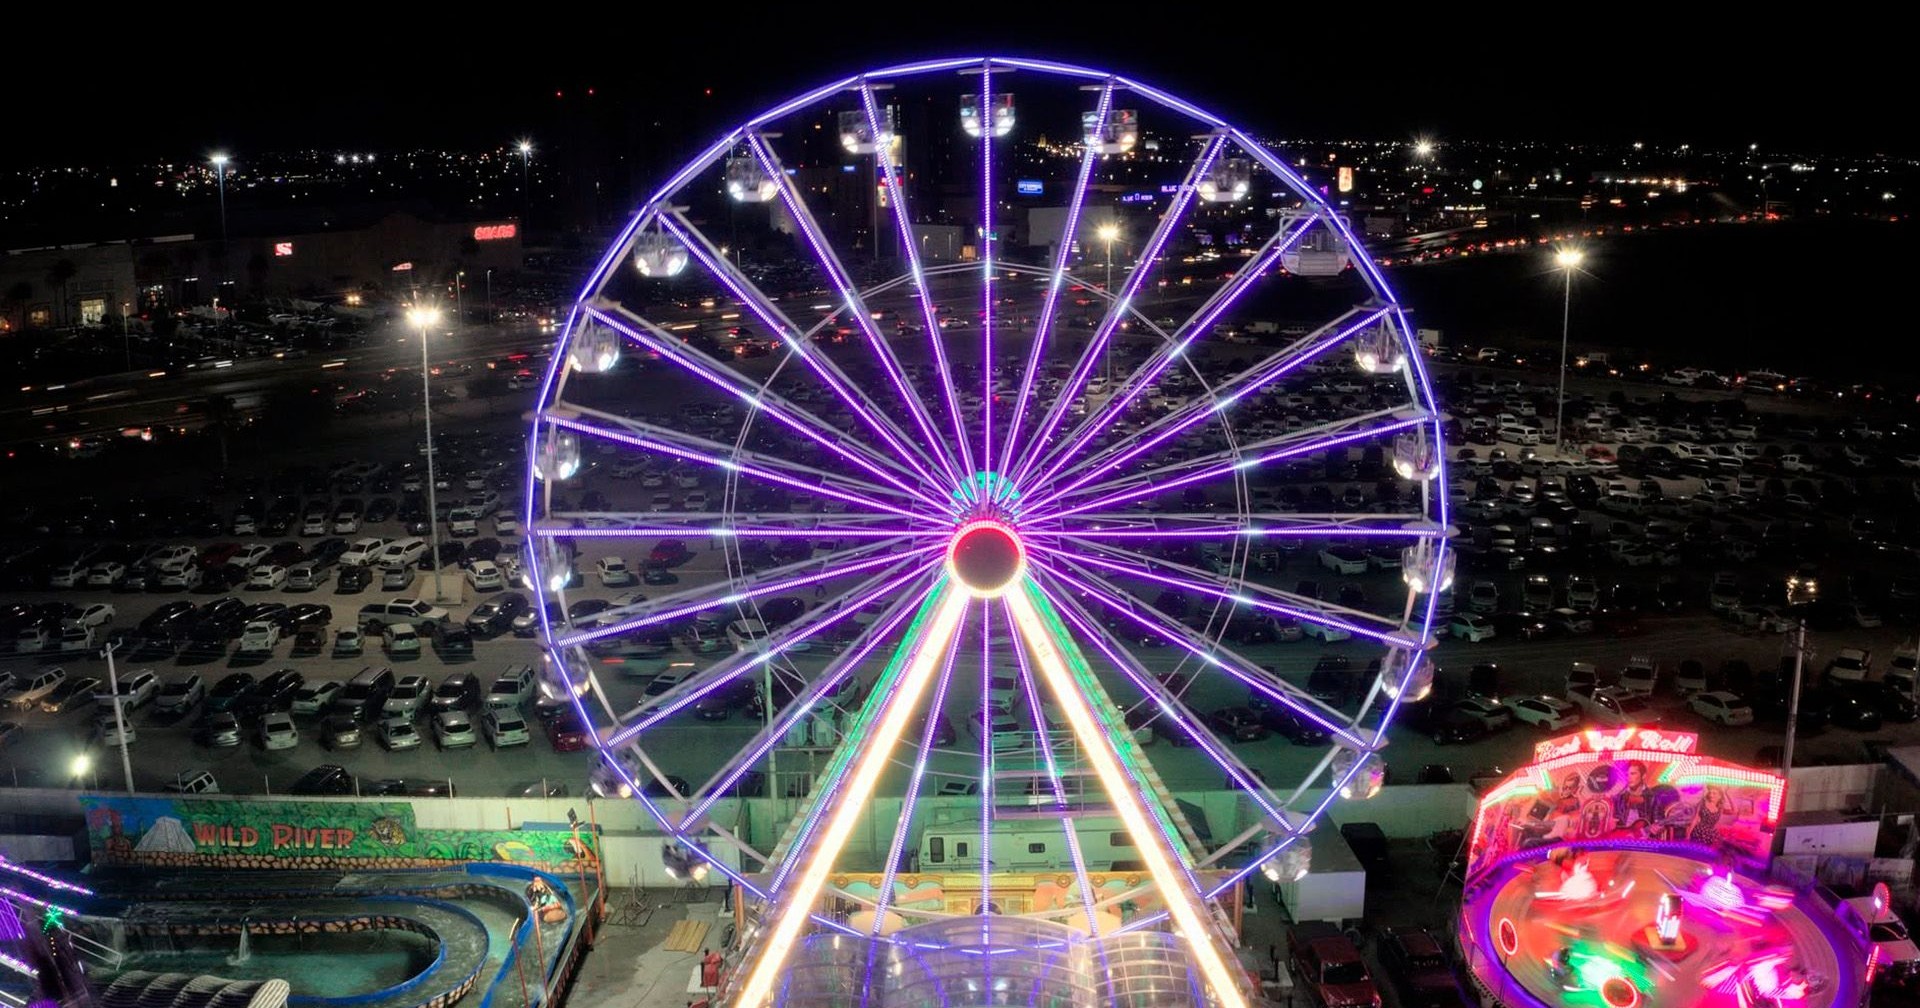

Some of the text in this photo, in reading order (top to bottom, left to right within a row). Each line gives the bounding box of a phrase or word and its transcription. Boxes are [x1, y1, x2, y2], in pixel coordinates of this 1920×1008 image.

[474, 224, 516, 240] SEARS
[1638, 730, 1694, 753] Roll
[193, 822, 355, 850] WILD RIVER
